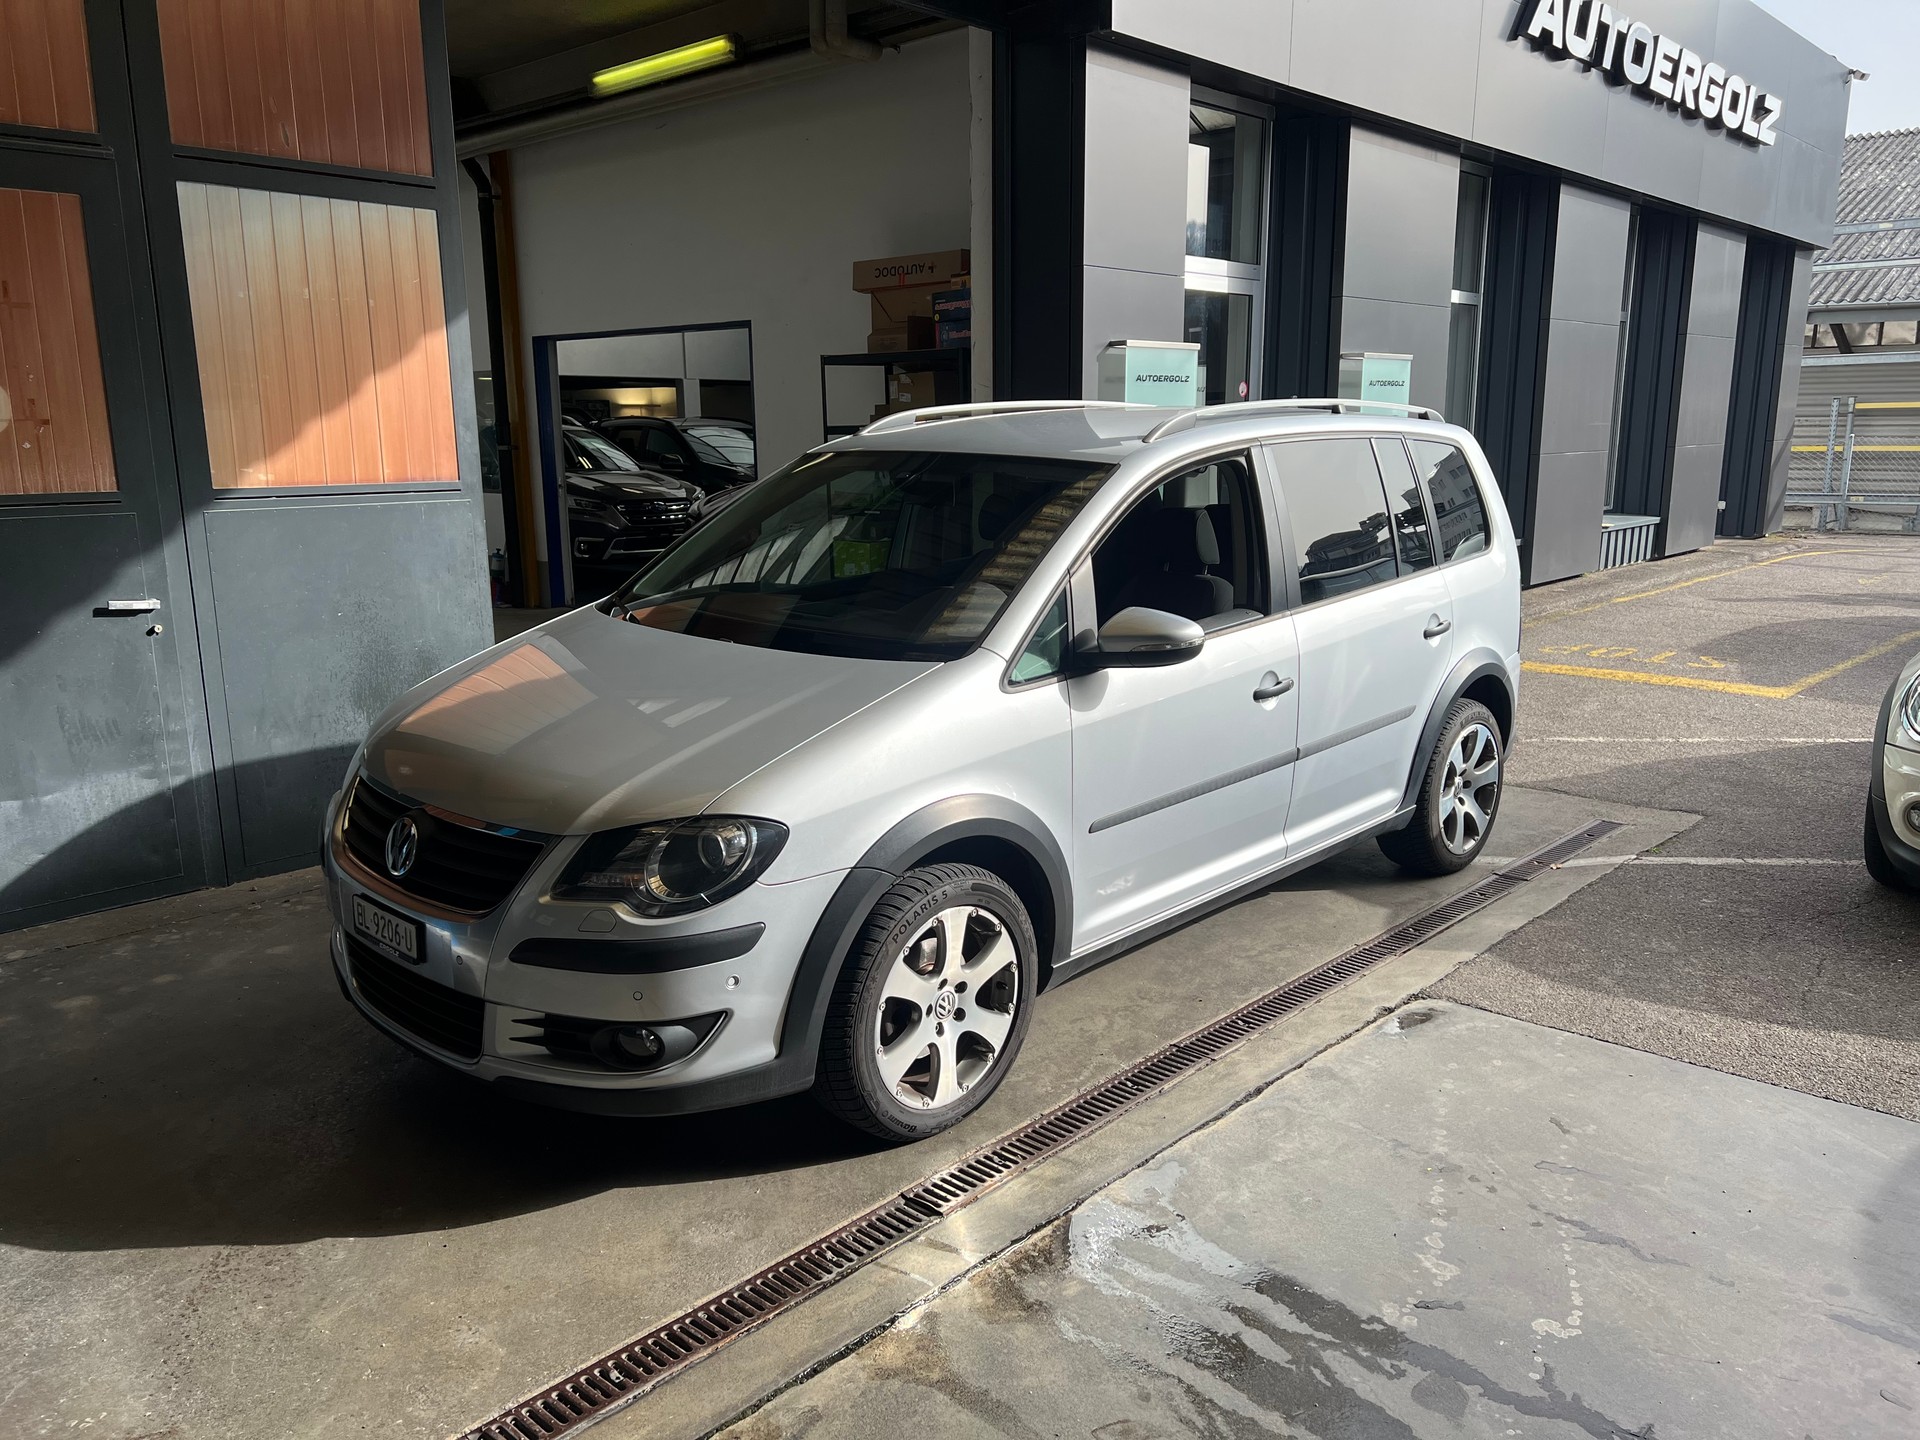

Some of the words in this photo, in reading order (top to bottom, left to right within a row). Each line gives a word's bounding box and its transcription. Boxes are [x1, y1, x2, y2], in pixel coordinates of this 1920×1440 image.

[1527, 0, 1783, 147] AUTOERGOLZ
[874, 262, 927, 279] AUTODOC
[1135, 374, 1190, 383] AUTOERGOLZ
[1368, 379, 1406, 387] AUTOERGOLZ
[891, 895, 939, 944] POLARIS
[941, 889, 948, 900] 5
